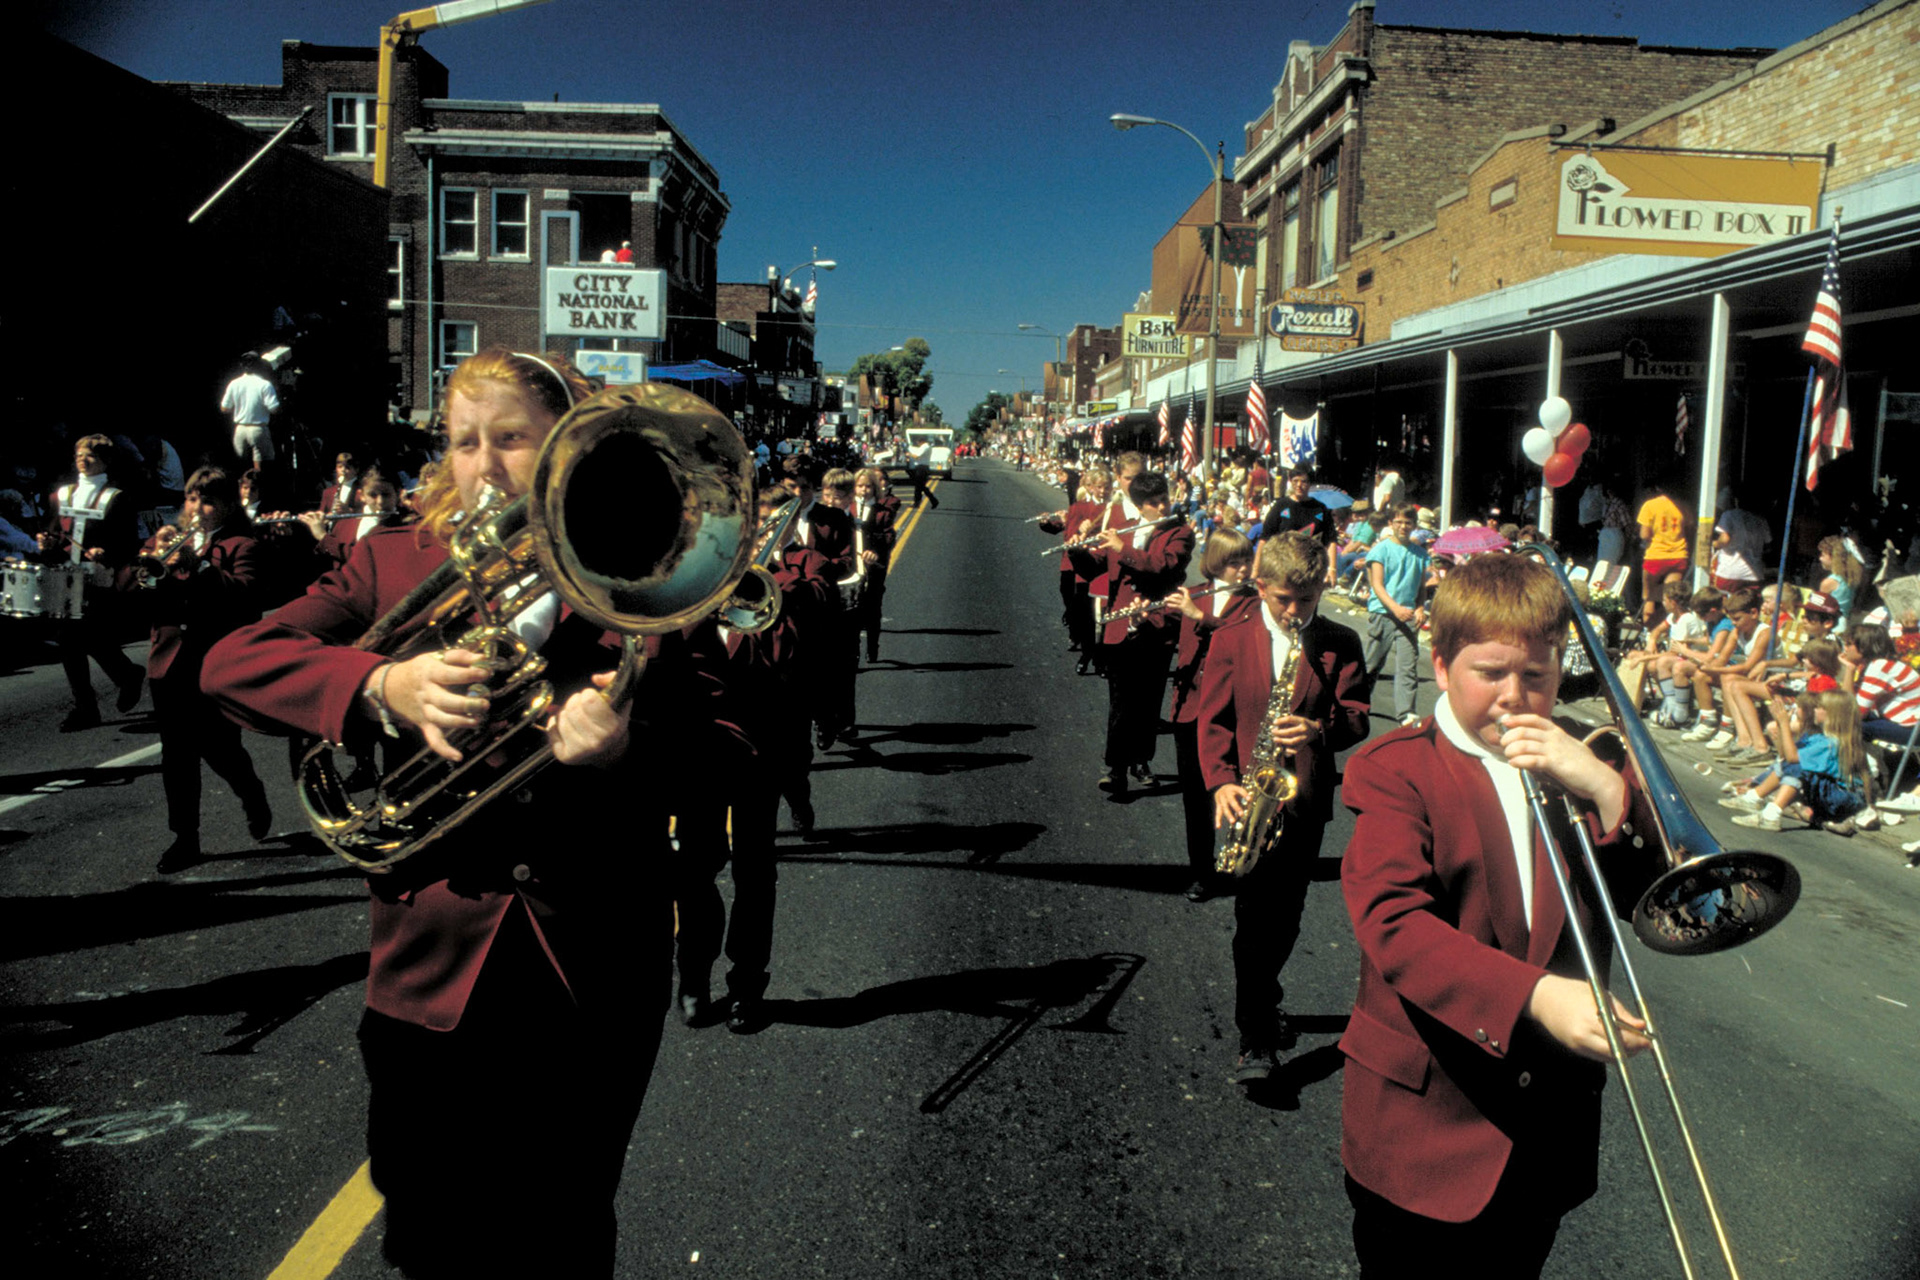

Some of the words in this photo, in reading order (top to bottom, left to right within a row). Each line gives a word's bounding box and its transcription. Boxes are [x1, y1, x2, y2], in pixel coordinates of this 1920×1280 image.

[1574, 189, 1702, 230] FLOWER
[1714, 211, 1777, 235] BOX
[1785, 215, 1806, 236] II
[574, 274, 632, 293] CITY
[558, 293, 648, 311] NATIONAL
[569, 310, 637, 331] BANK
[1139, 320, 1176, 337] B&K
[1275, 304, 1354, 334] Rexall
[1128, 332, 1186, 355] FURNITURE
[1287, 337, 1341, 352] DRUGS
[587, 354, 632, 380] 24
